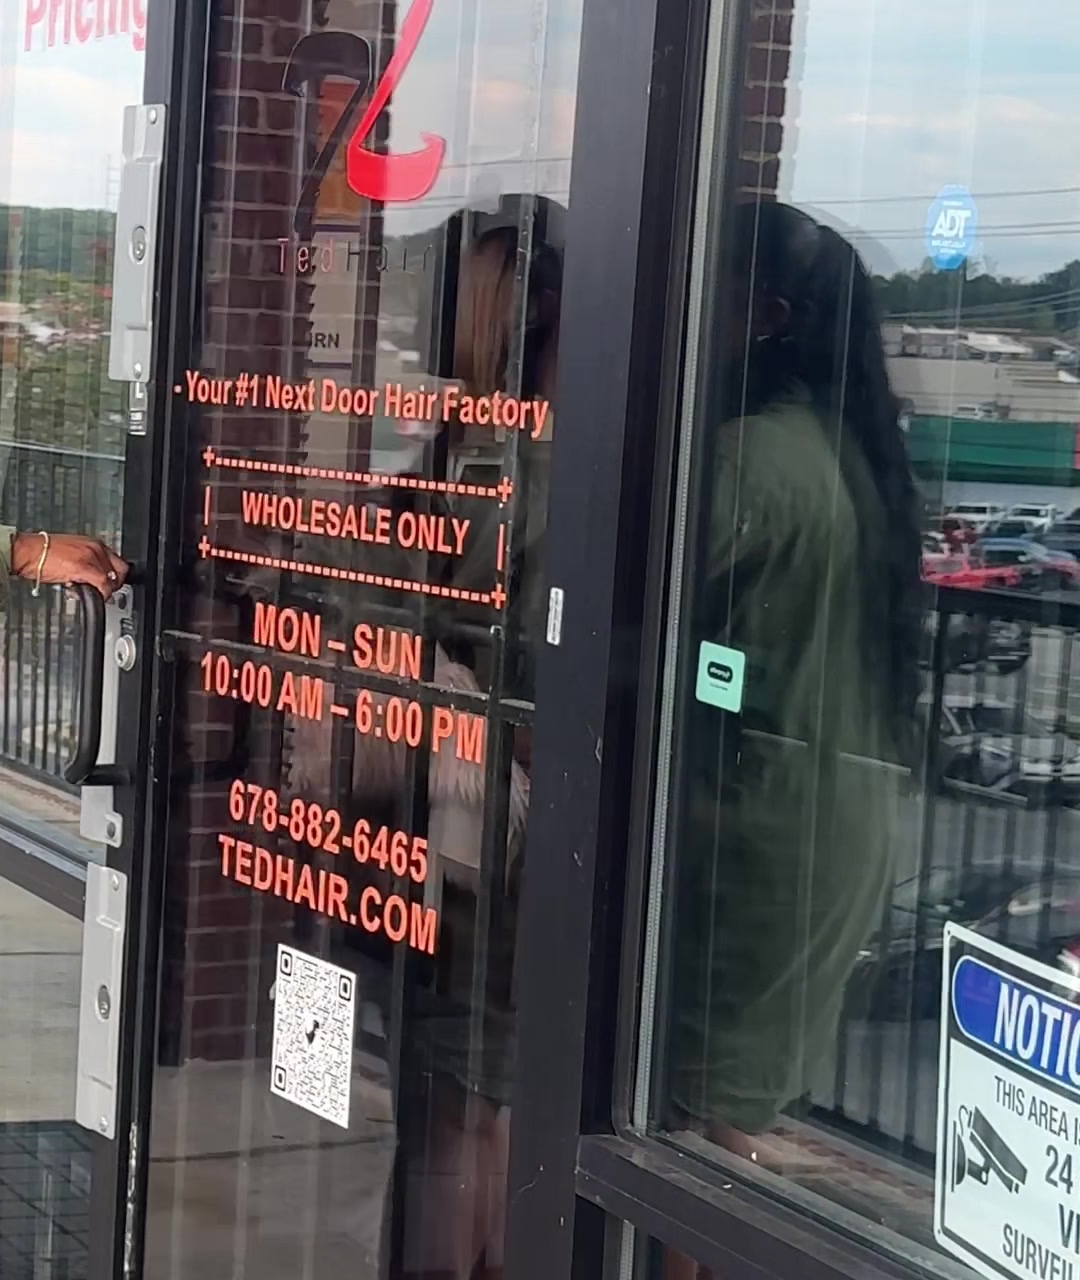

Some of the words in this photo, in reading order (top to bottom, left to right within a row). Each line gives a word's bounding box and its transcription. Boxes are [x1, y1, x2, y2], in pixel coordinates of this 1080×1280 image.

[931, 209, 971, 238] ADT
[186, 370, 233, 406] Your
[235, 373, 259, 407] #1
[265, 375, 315, 412] Next
[321, 378, 378, 416] Door
[384, 383, 437, 421] Hair
[443, 387, 549, 438] Factory
[242, 490, 391, 545] WHOLESALE
[397, 511, 470, 556] ONLY
[253, 602, 321, 658] MON
[353, 623, 422, 680] SUN
[201, 651, 272, 708] 10:00
[277, 671, 324, 721] AM
[355, 689, 423, 747] 6:00
[432, 706, 485, 766] PM
[229, 778, 429, 883] 678-882-6465
[218, 834, 438, 956] TEDHAIR.COM
[994, 1075, 1025, 1117] THIS
[1028, 1096, 1070, 1142] AREA
[1045, 1144, 1073, 1195] 24
